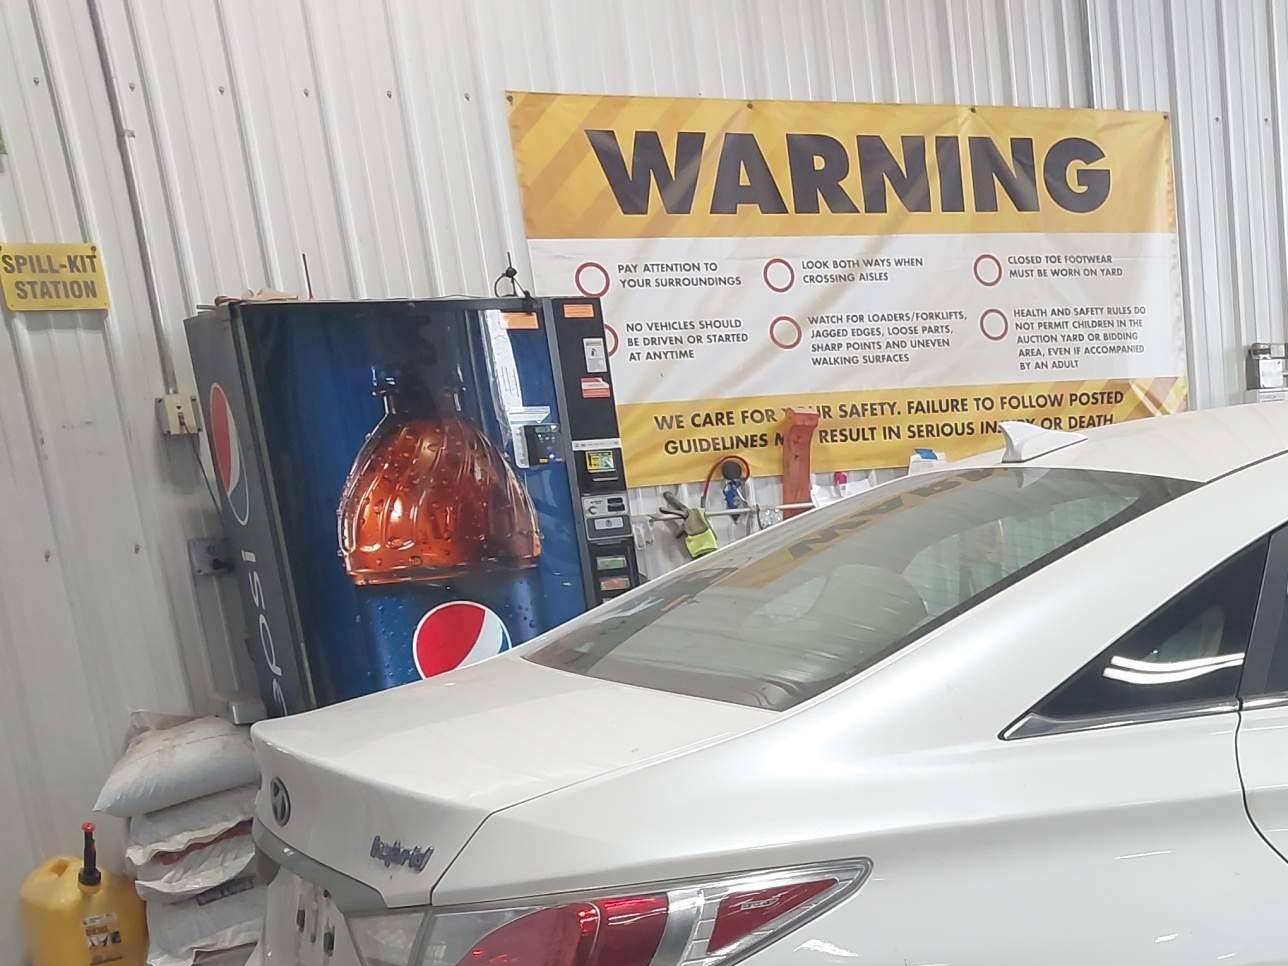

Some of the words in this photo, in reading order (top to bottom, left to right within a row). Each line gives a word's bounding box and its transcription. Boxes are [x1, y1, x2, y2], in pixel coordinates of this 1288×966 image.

[584, 129, 1111, 215] WARNING
[2, 254, 96, 274] SPILL-KIT
[801, 260, 830, 269] LOOK
[833, 259, 859, 269] BOTH
[863, 259, 891, 267] WAYS
[894, 258, 923, 266] WHEN
[1008, 256, 1041, 265] CLOSED
[1045, 256, 1061, 264] TOE
[1065, 255, 1112, 264] FOOTWEAR
[618, 264, 638, 273] PAY
[643, 263, 700, 273] ATTENTION
[704, 263, 717, 271] TO
[1010, 269, 1033, 278] MUST
[1037, 269, 1048, 277] BE
[1051, 268, 1081, 277] WORN
[1084, 268, 1097, 276] ON
[1101, 268, 1123, 276] YARD
[619, 279, 651, 288] YOUR
[655, 277, 742, 287] SURROUNDINGS
[803, 274, 855, 284] CROSSING
[859, 272, 888, 281] AISLES
[15, 280, 97, 299] STATION
[808, 315, 843, 325] WATCH
[846, 314, 864, 323] FOR
[868, 311, 967, 322] LOADERS/FORKLIFTS,
[1014, 309, 1047, 318] HEALTH
[1051, 308, 1070, 316] AND
[1074, 307, 1104, 316] SAFETY
[1107, 307, 1132, 315] RULES
[1134, 306, 1145, 314] DO
[626, 323, 643, 332] NO
[646, 321, 695, 331] VEHICLES
[699, 320, 742, 329] SHOULD
[1016, 322, 1034, 330] NOT
[1038, 321, 1068, 330] PERMIT
[1072, 320, 1114, 329] CHILDREN
[1129, 319, 1142, 327] THE
[811, 328, 848, 339] JAGGED
[852, 327, 884, 337] EDGES,
[888, 326, 918, 336] LOOSE
[922, 325, 953, 334] PARTS,
[1017, 335, 1057, 344] AUCTION
[1060, 334, 1084, 342] YARD
[1088, 333, 1100, 341] OR
[1104, 332, 1137, 341] BIDDING
[628, 337, 639, 346] BE
[644, 336, 683, 346] DRIVEN
[687, 335, 702, 344] OR
[707, 333, 748, 343] STARTED
[811, 343, 842, 352] SHARP
[846, 341, 882, 351] POINTS
[885, 340, 907, 349] AND
[911, 339, 950, 348] UNEVEN
[629, 352, 641, 361] AT
[646, 350, 694, 360] ANYTIME
[1019, 348, 1045, 357] AREA,
[1048, 347, 1070, 356] EVEN
[1074, 347, 1080, 355] IF
[1084, 345, 1144, 354] ACCOMPANIED
[812, 356, 859, 366] WALKING
[863, 354, 909, 364] SURFACES
[1020, 362, 1031, 370] BY
[1034, 361, 1048, 369] AN
[1052, 360, 1079, 369] ADULT
[654, 413, 685, 430] WE
[690, 410, 735, 428] CARE
[741, 408, 778, 425] FOR
[838, 401, 901, 419] SAFETY.
[907, 395, 968, 415] FAILURE
[973, 394, 994, 411] TO
[1000, 392, 1065, 410] FOLLOW
[1069, 390, 1124, 406] POSTED
[664, 433, 769, 455] GUIDELINES
[819, 426, 877, 444] RESULT
[883, 425, 901, 440] IN
[907, 419, 975, 439] SERIOUS
[1040, 416, 1063, 430] OR
[1068, 414, 1114, 429] DEATH
